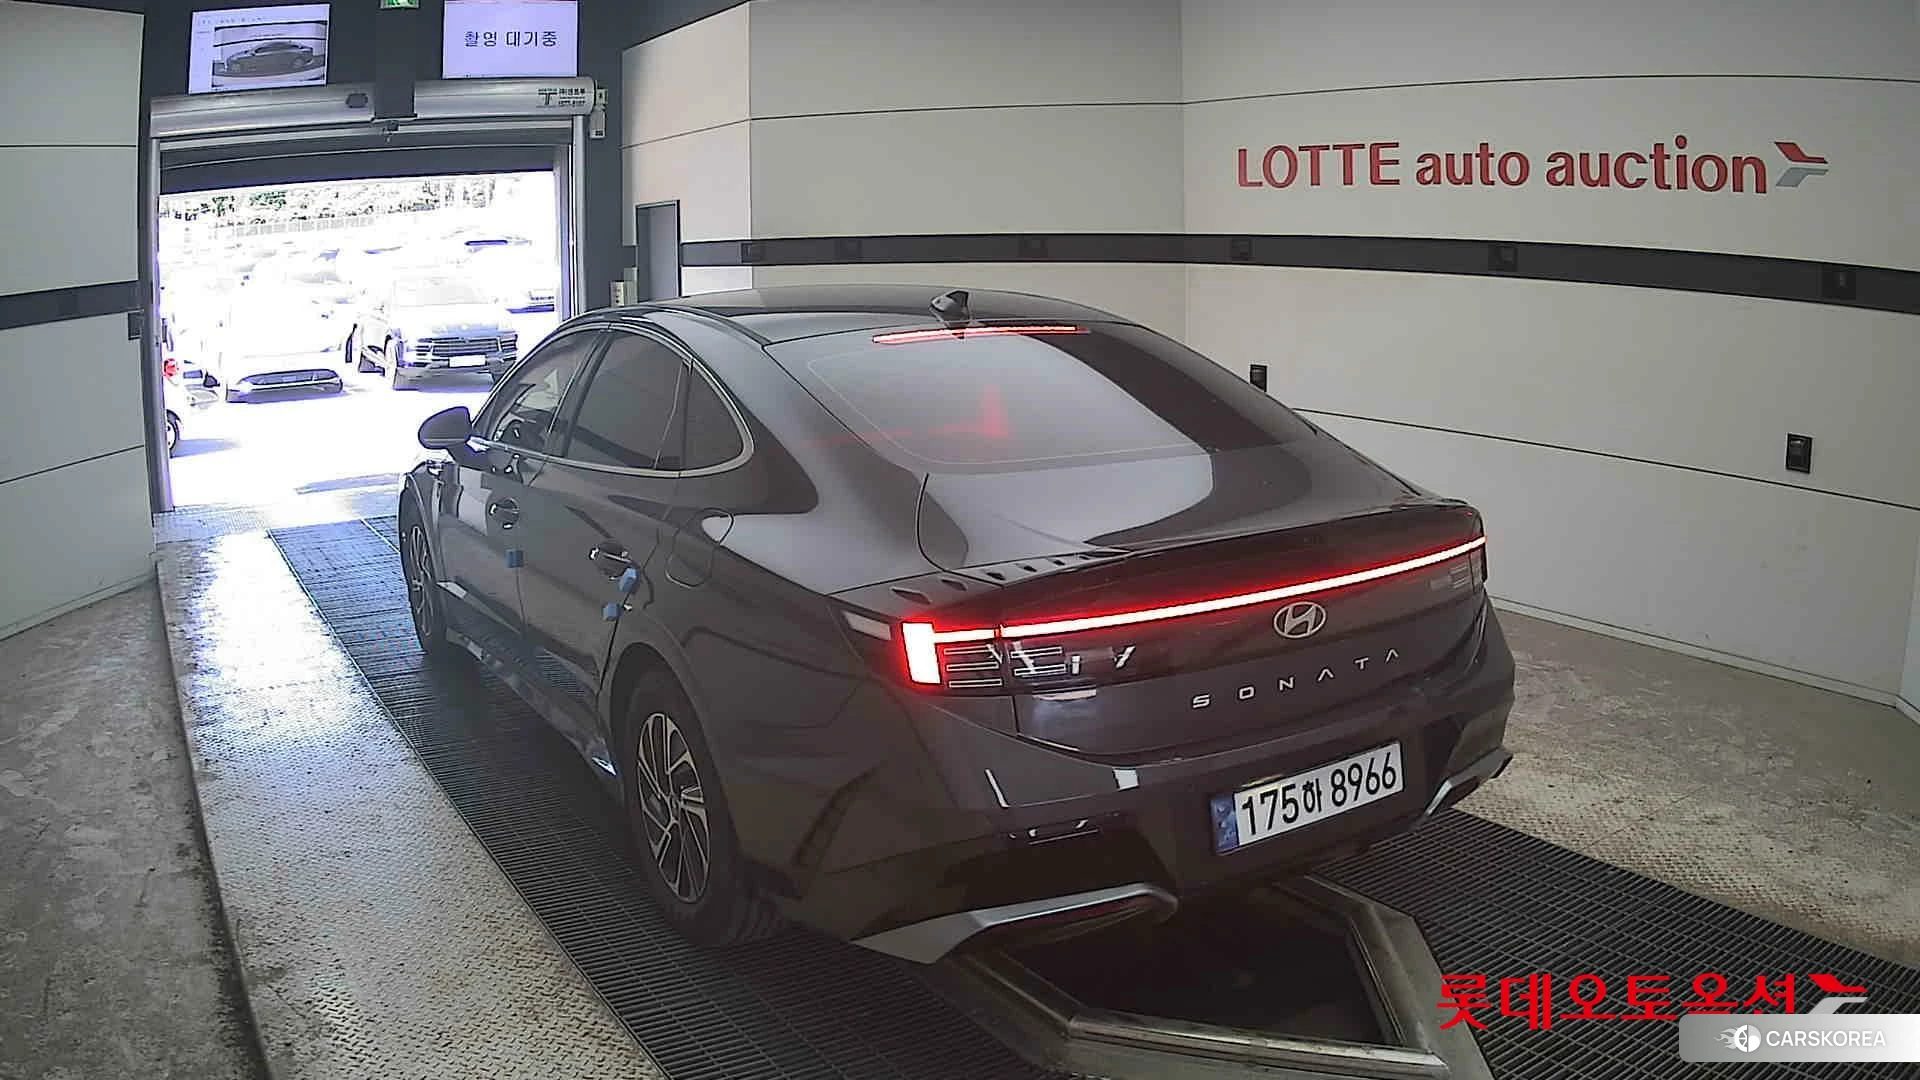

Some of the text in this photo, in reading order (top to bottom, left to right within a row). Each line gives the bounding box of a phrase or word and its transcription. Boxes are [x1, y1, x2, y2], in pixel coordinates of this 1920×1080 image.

[505, 31, 557, 47] 대기중
[1237, 135, 1767, 194] LOTTE auto auction
[1192, 649, 1399, 708] SONATA
[1241, 751, 1397, 836] 175하 8966
